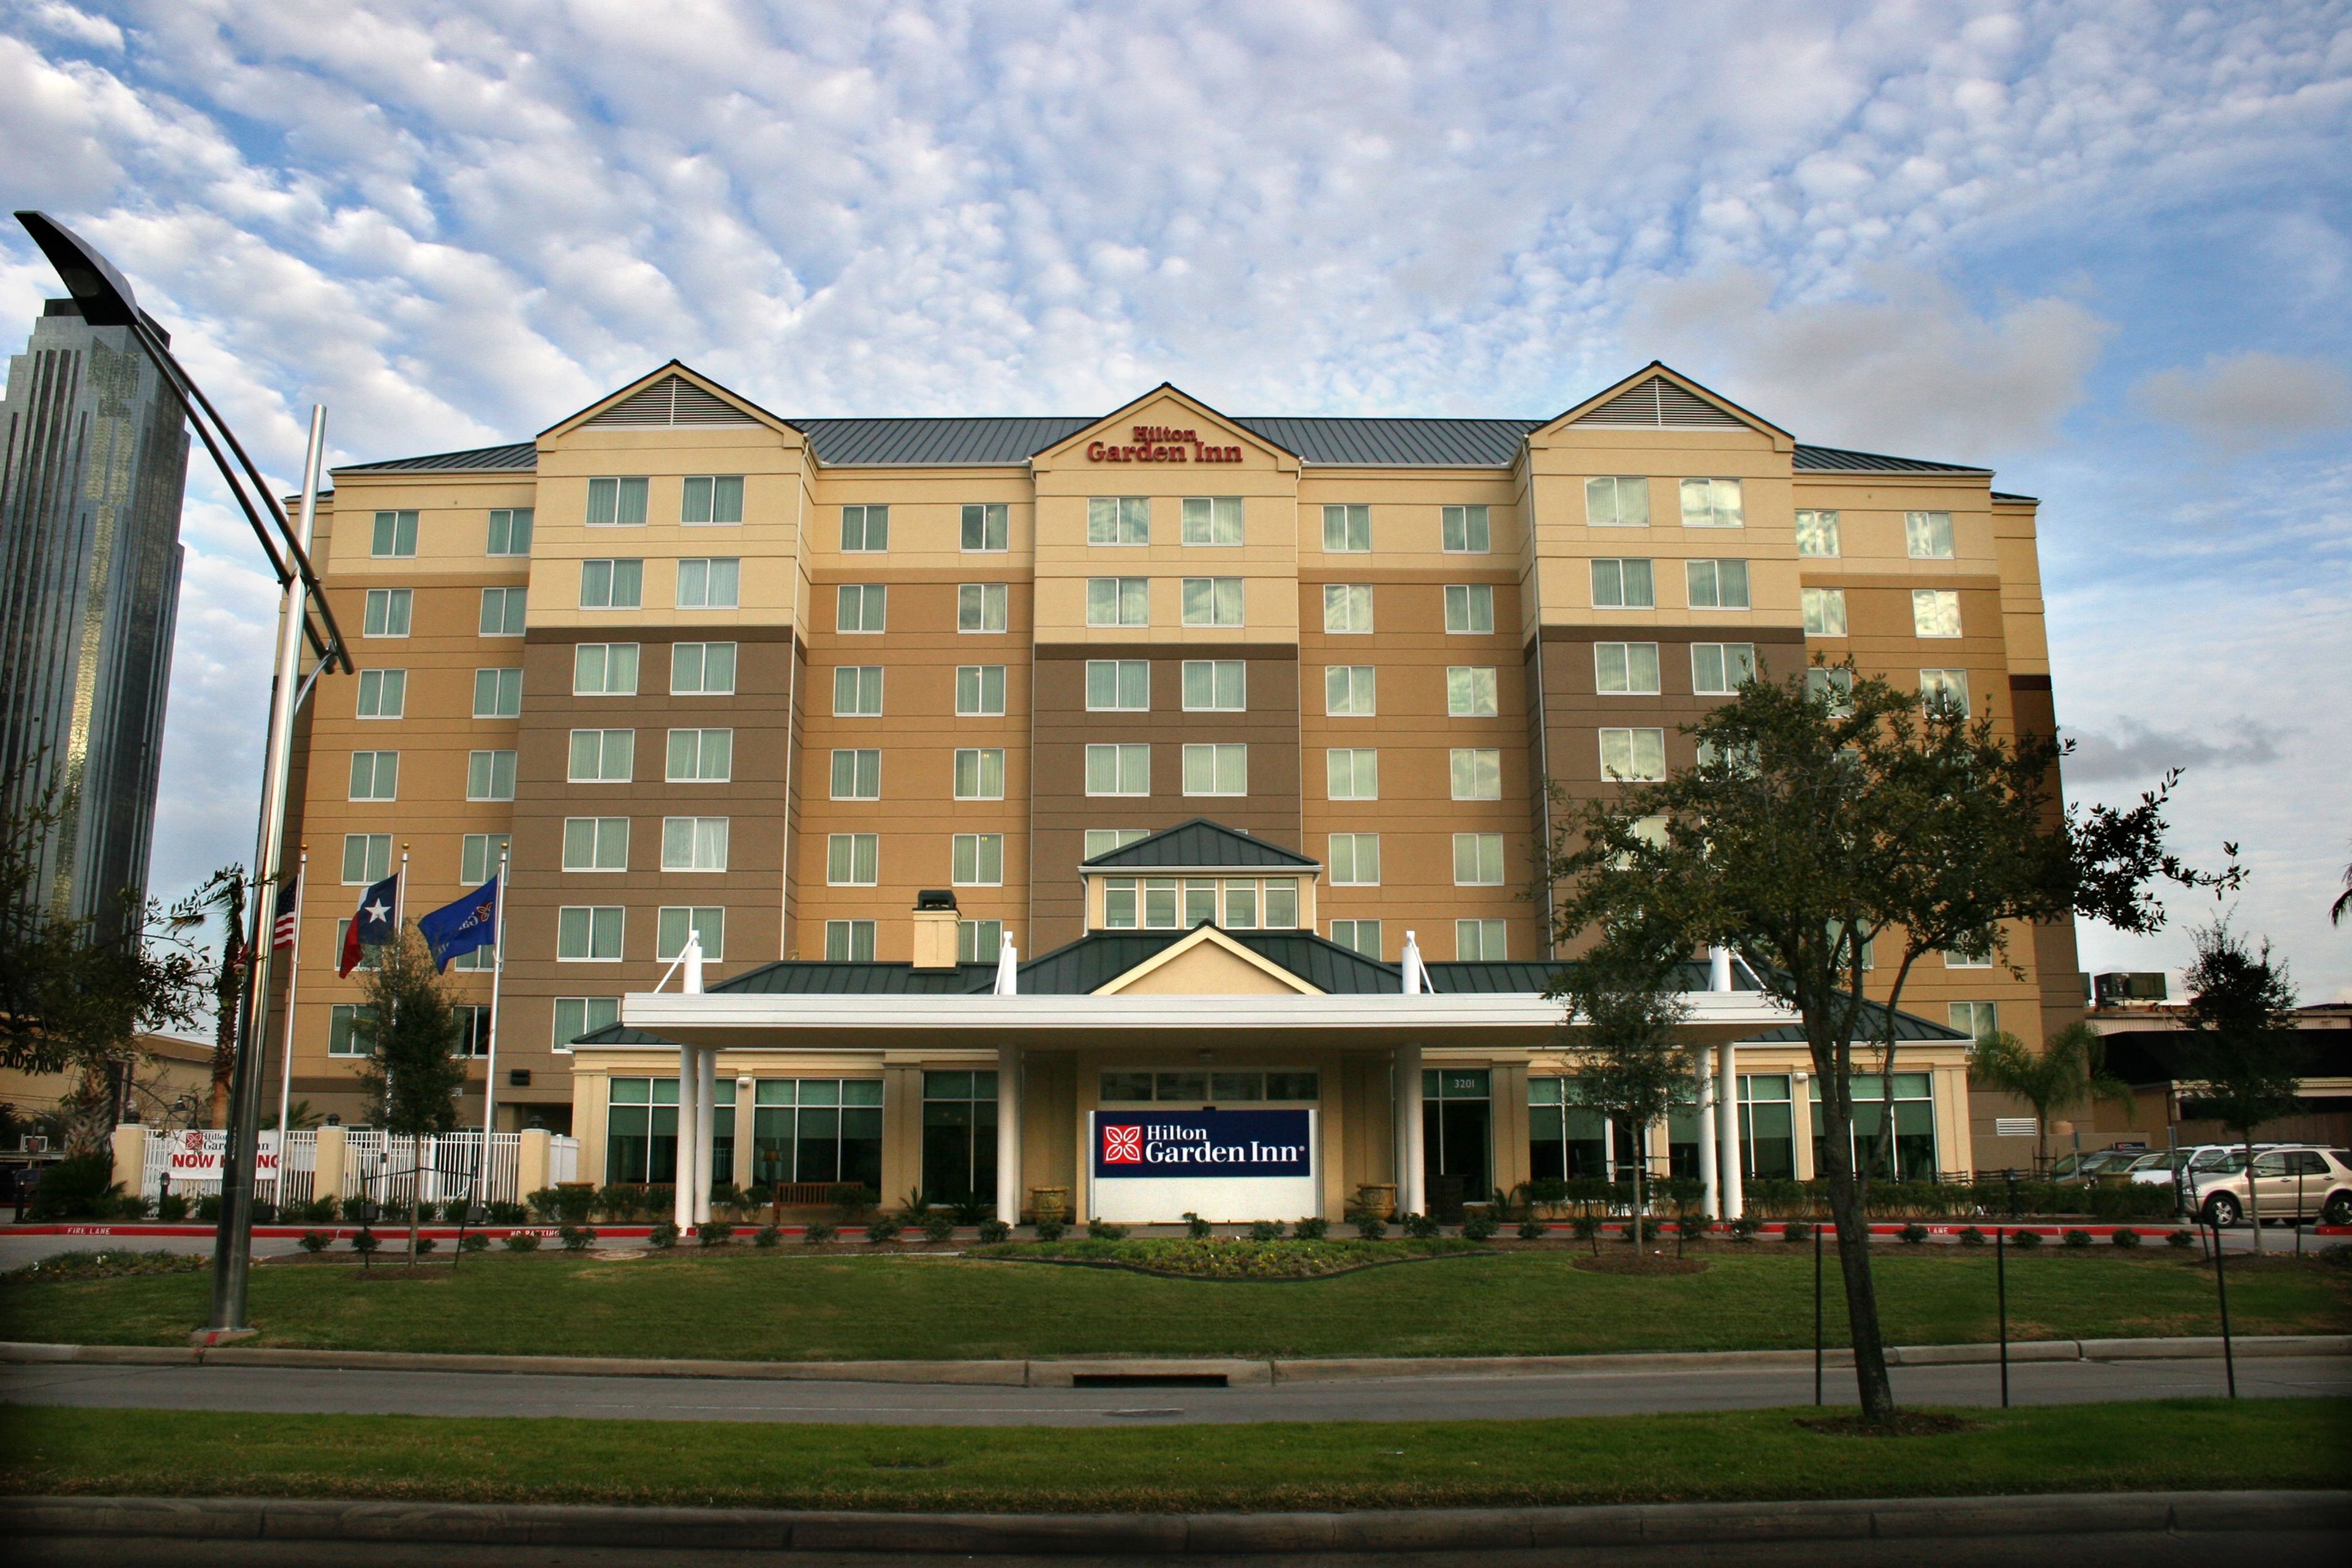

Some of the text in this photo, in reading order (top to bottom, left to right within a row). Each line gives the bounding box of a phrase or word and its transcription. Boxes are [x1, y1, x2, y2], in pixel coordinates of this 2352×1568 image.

[1133, 426, 1197, 442] Hilton
[1087, 441, 1243, 462] Garden Inn
[1454, 1079, 1475, 1088] 3201
[1147, 1125, 1207, 1140] Hilton
[1145, 1141, 1246, 1163] Garden
[172, 1154, 214, 1168] NOW
